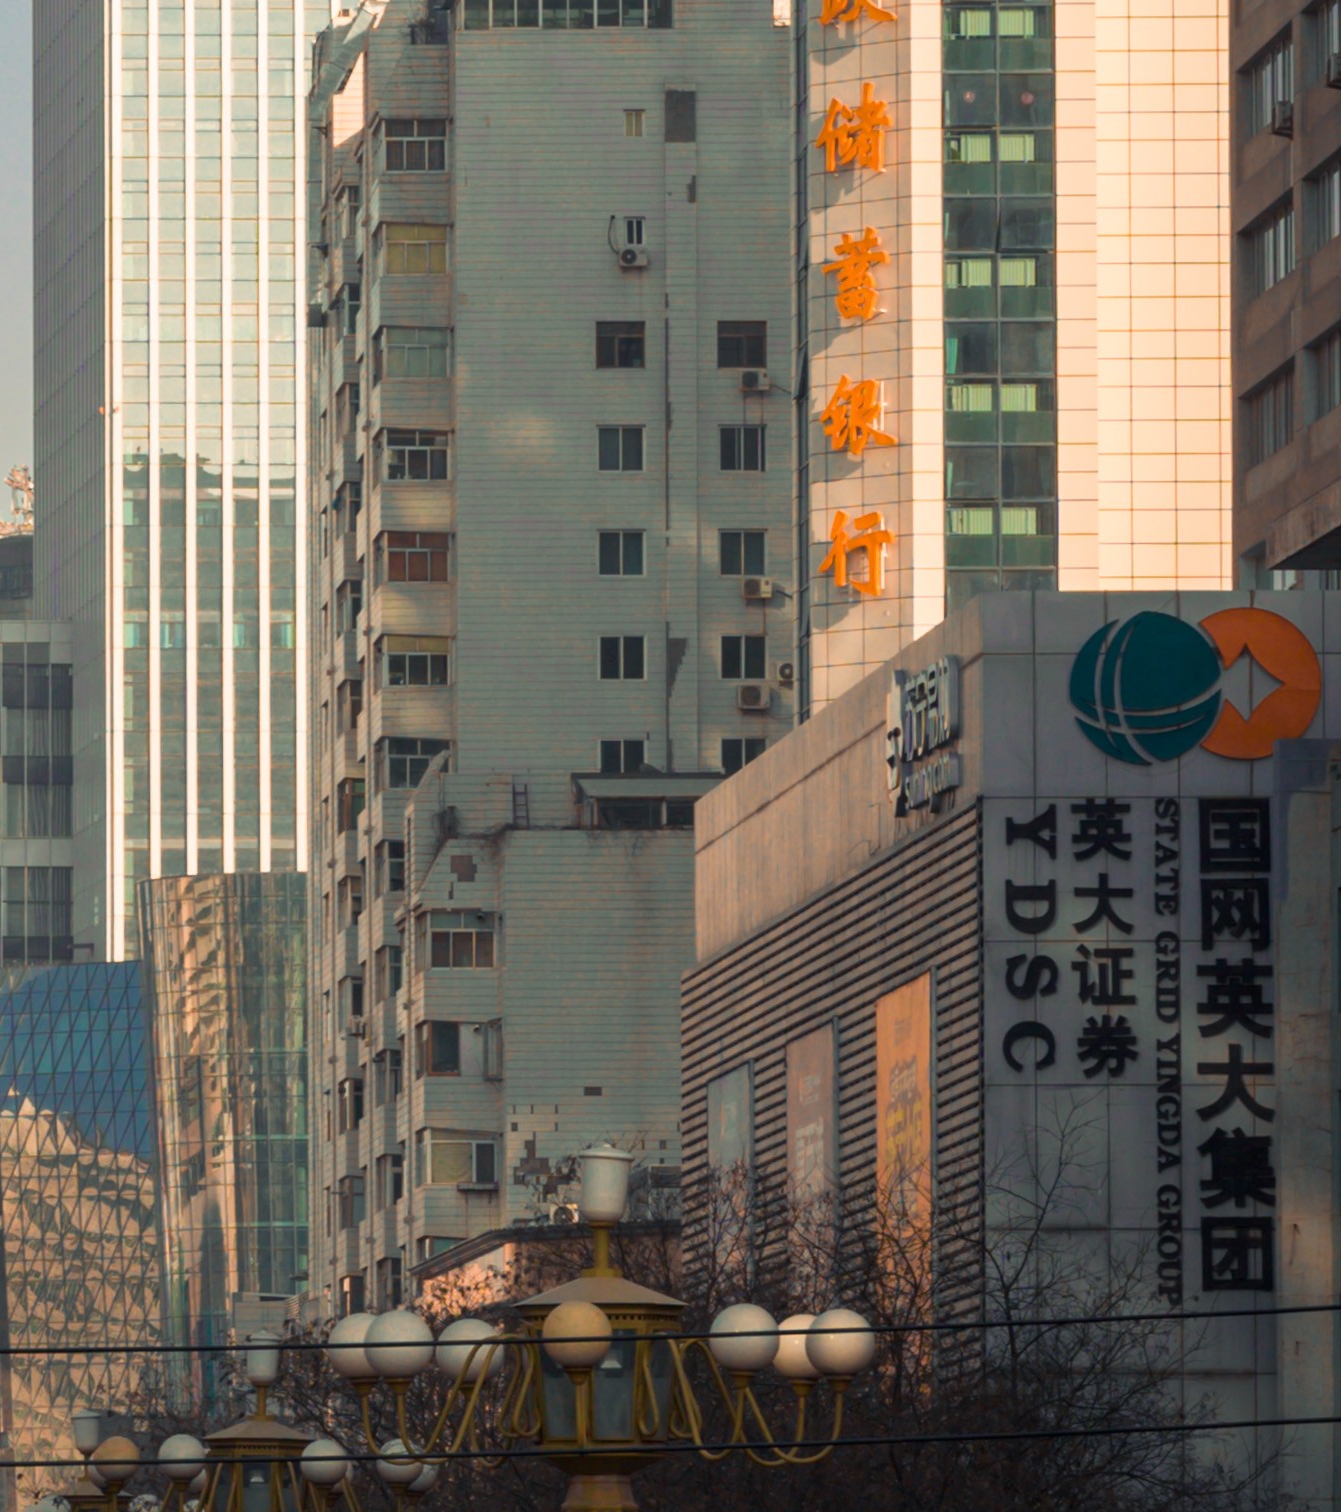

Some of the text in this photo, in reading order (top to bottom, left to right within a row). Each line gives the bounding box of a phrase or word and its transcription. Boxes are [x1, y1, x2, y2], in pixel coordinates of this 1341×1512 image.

[1071, 797, 1139, 1079] 英大证券
[1154, 796, 1183, 1307] STATE GRID YINGDA GROUP
[1196, 797, 1274, 1292] 国网英大集团
